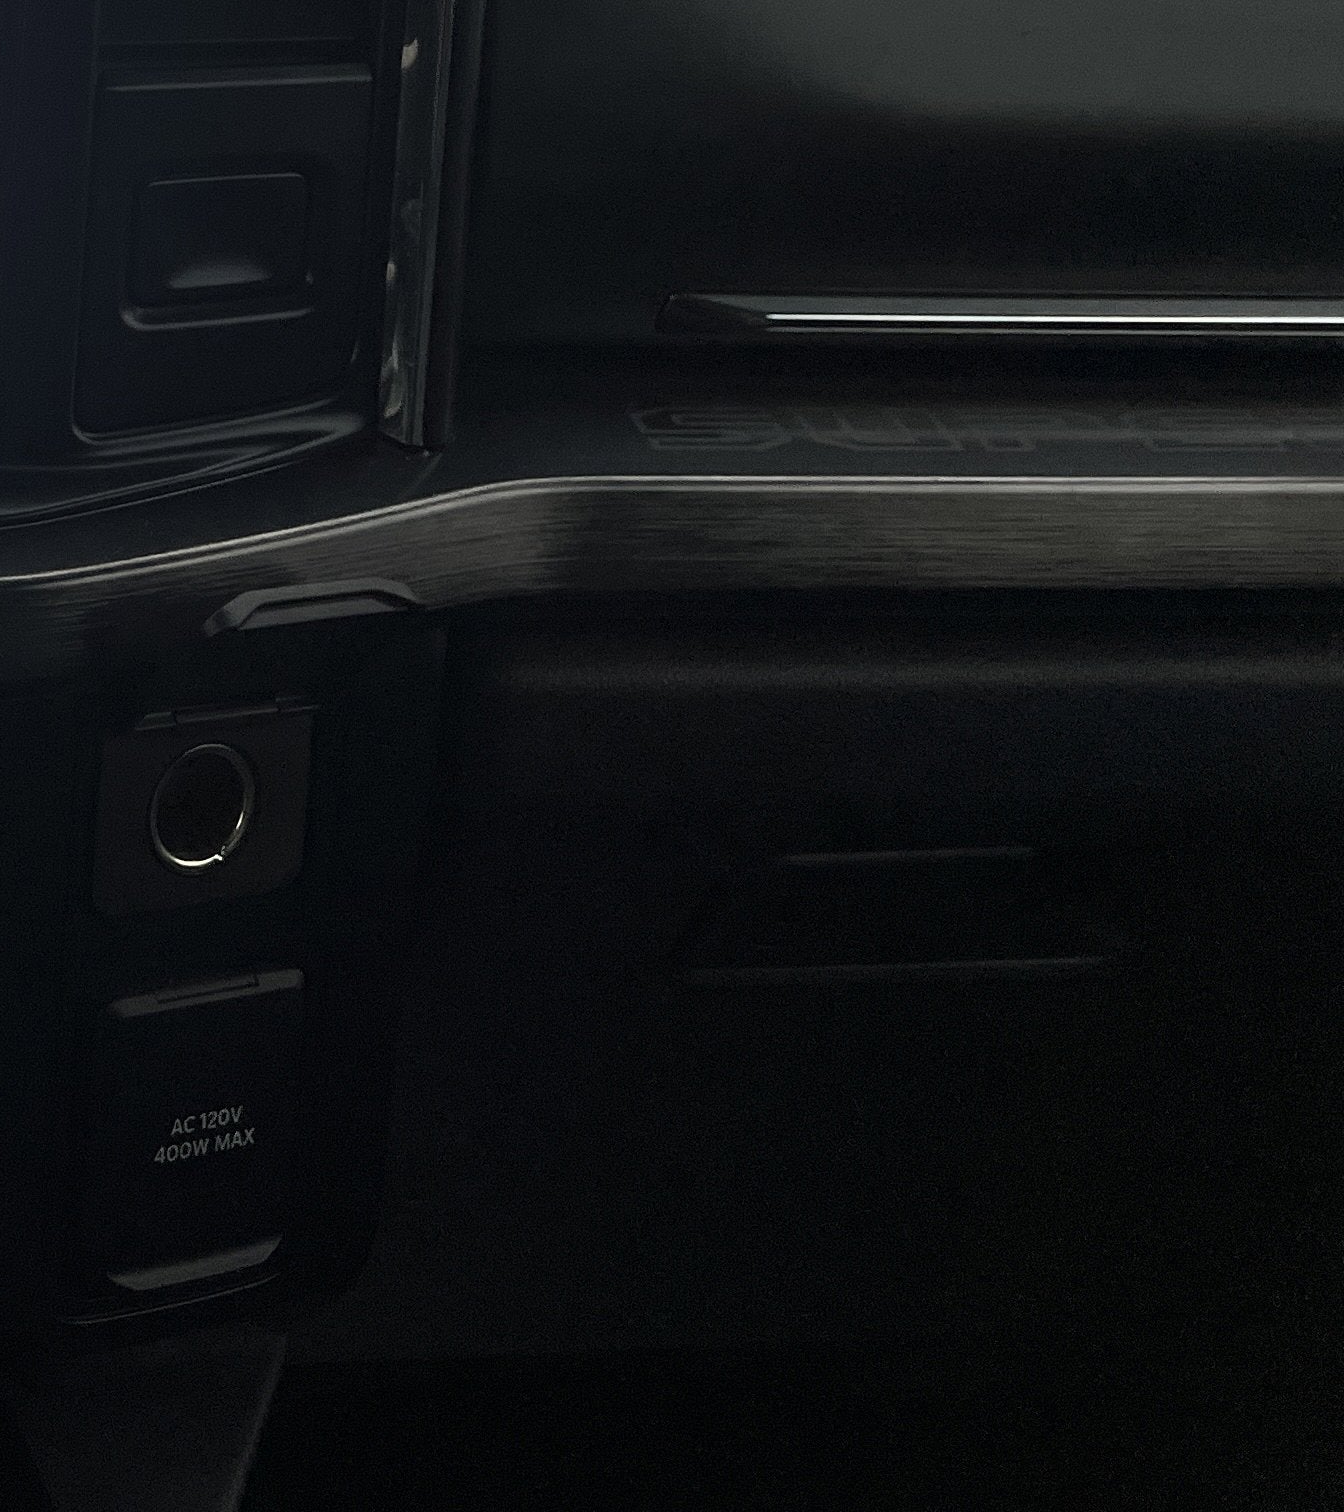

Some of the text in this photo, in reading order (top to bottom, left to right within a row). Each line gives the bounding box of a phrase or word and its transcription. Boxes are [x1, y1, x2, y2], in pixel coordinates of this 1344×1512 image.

[170, 1105, 244, 1135] AC 120V
[153, 1126, 256, 1163] 400W MAX
